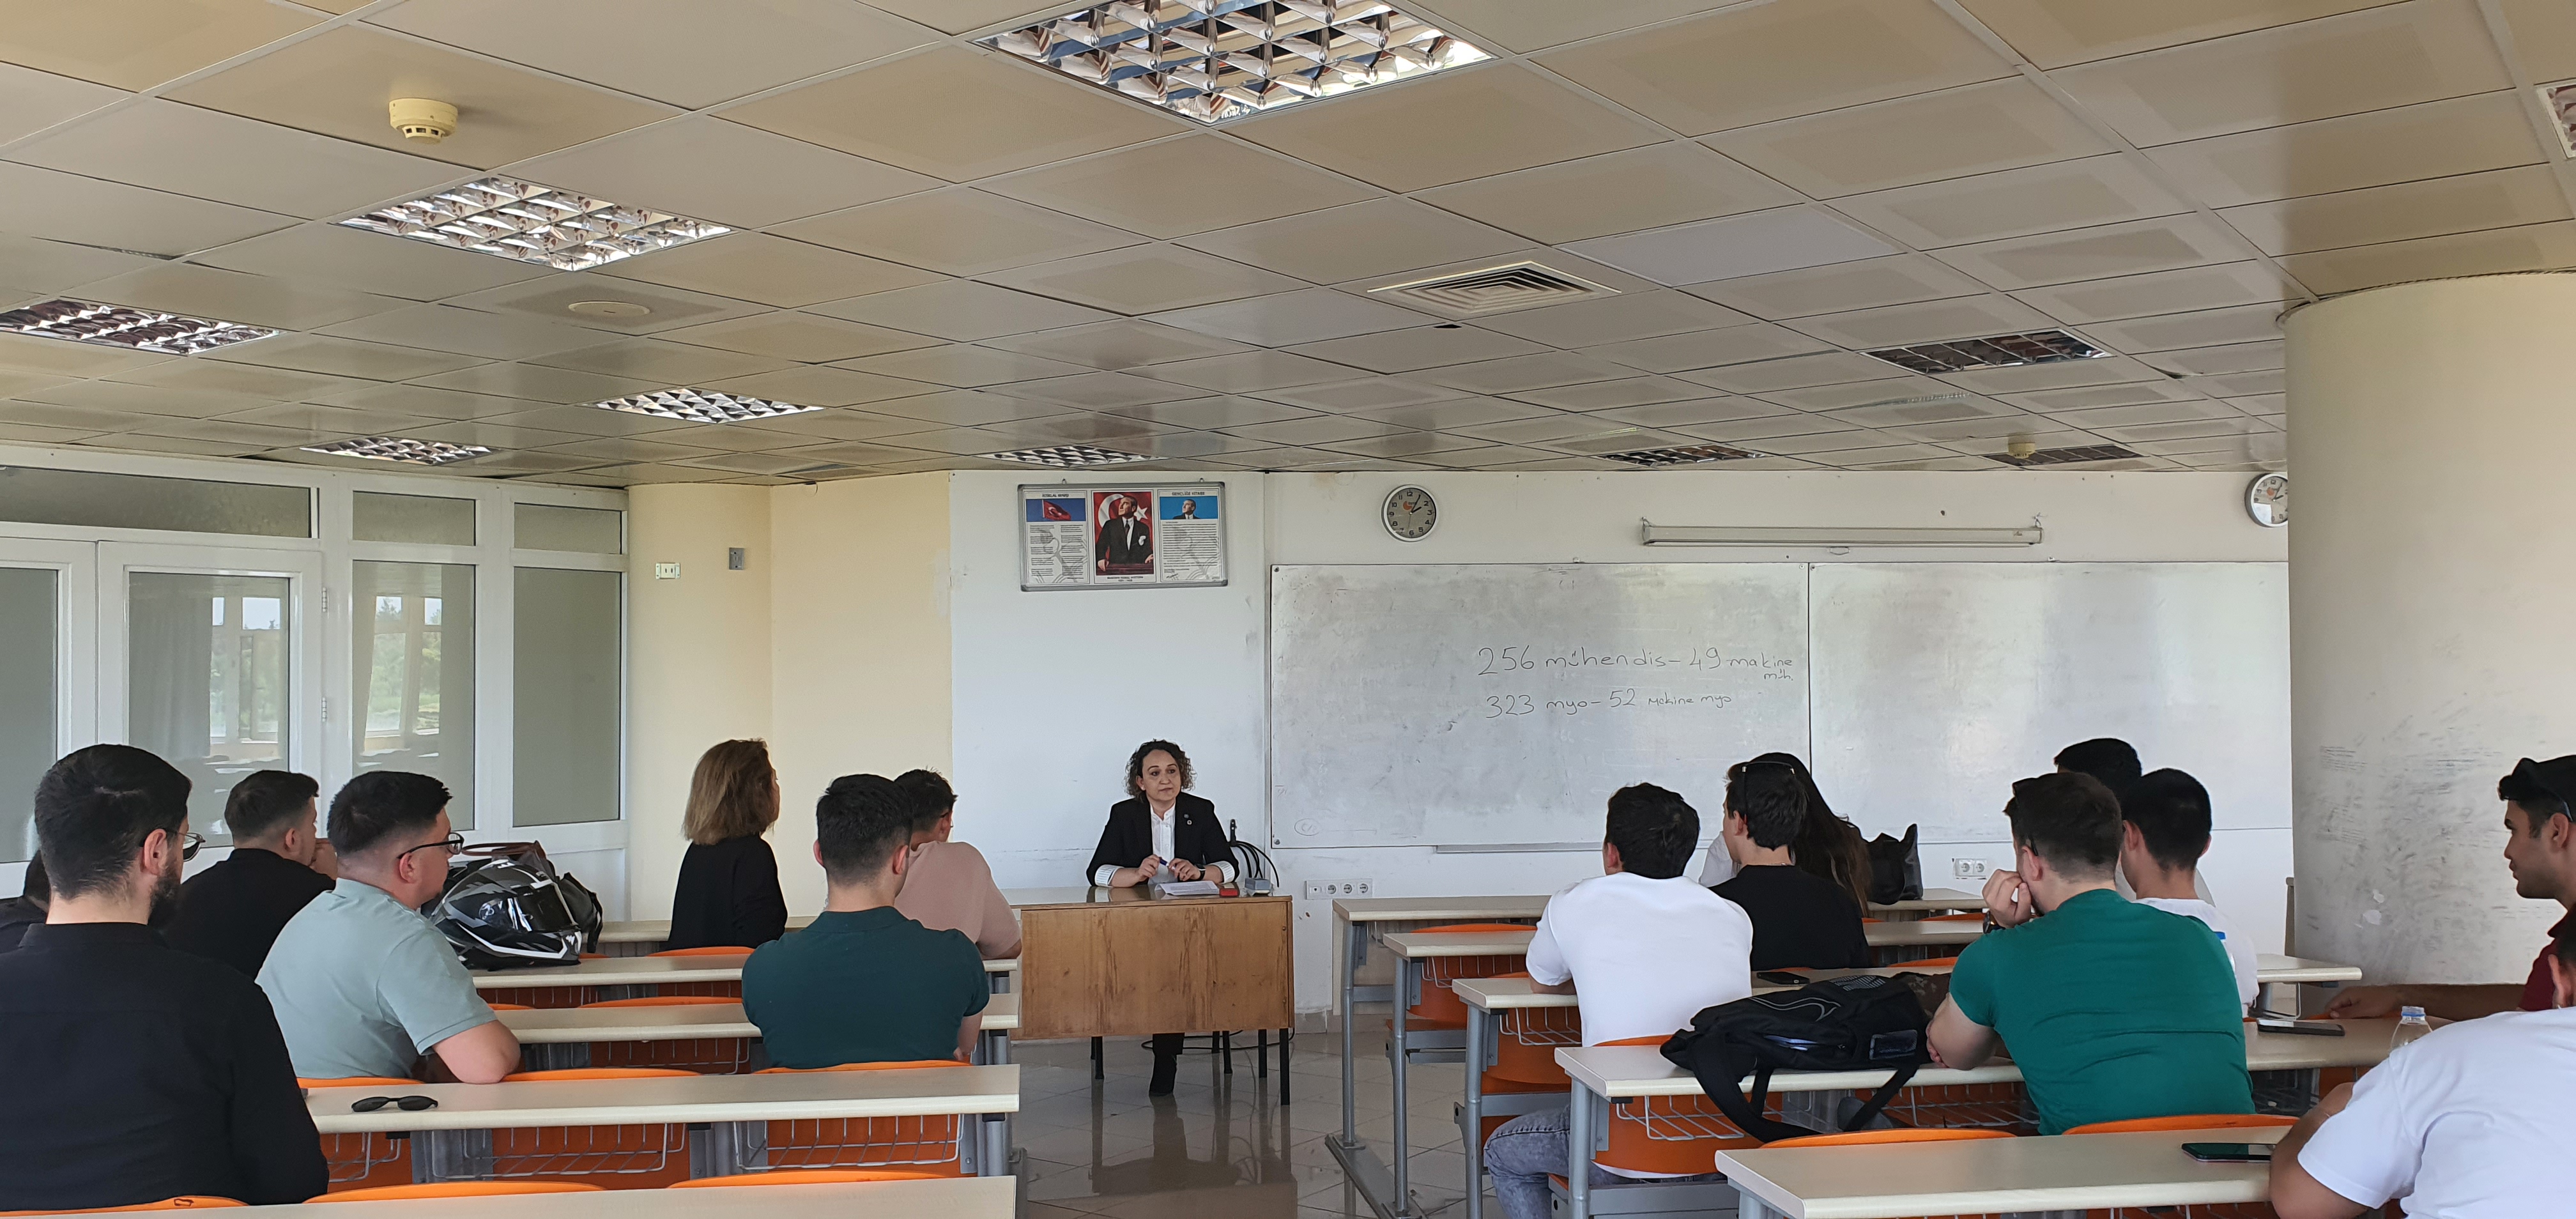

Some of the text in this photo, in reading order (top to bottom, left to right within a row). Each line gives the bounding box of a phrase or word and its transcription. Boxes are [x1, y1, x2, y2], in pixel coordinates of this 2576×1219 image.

[1478, 645, 1534, 675] 256
[1689, 647, 1721, 671] 49
[1726, 652, 1793, 668] makine
[1485, 694, 1535, 719] 323
[1609, 688, 1636, 708] 52
[1700, 694, 1732, 709] myo
